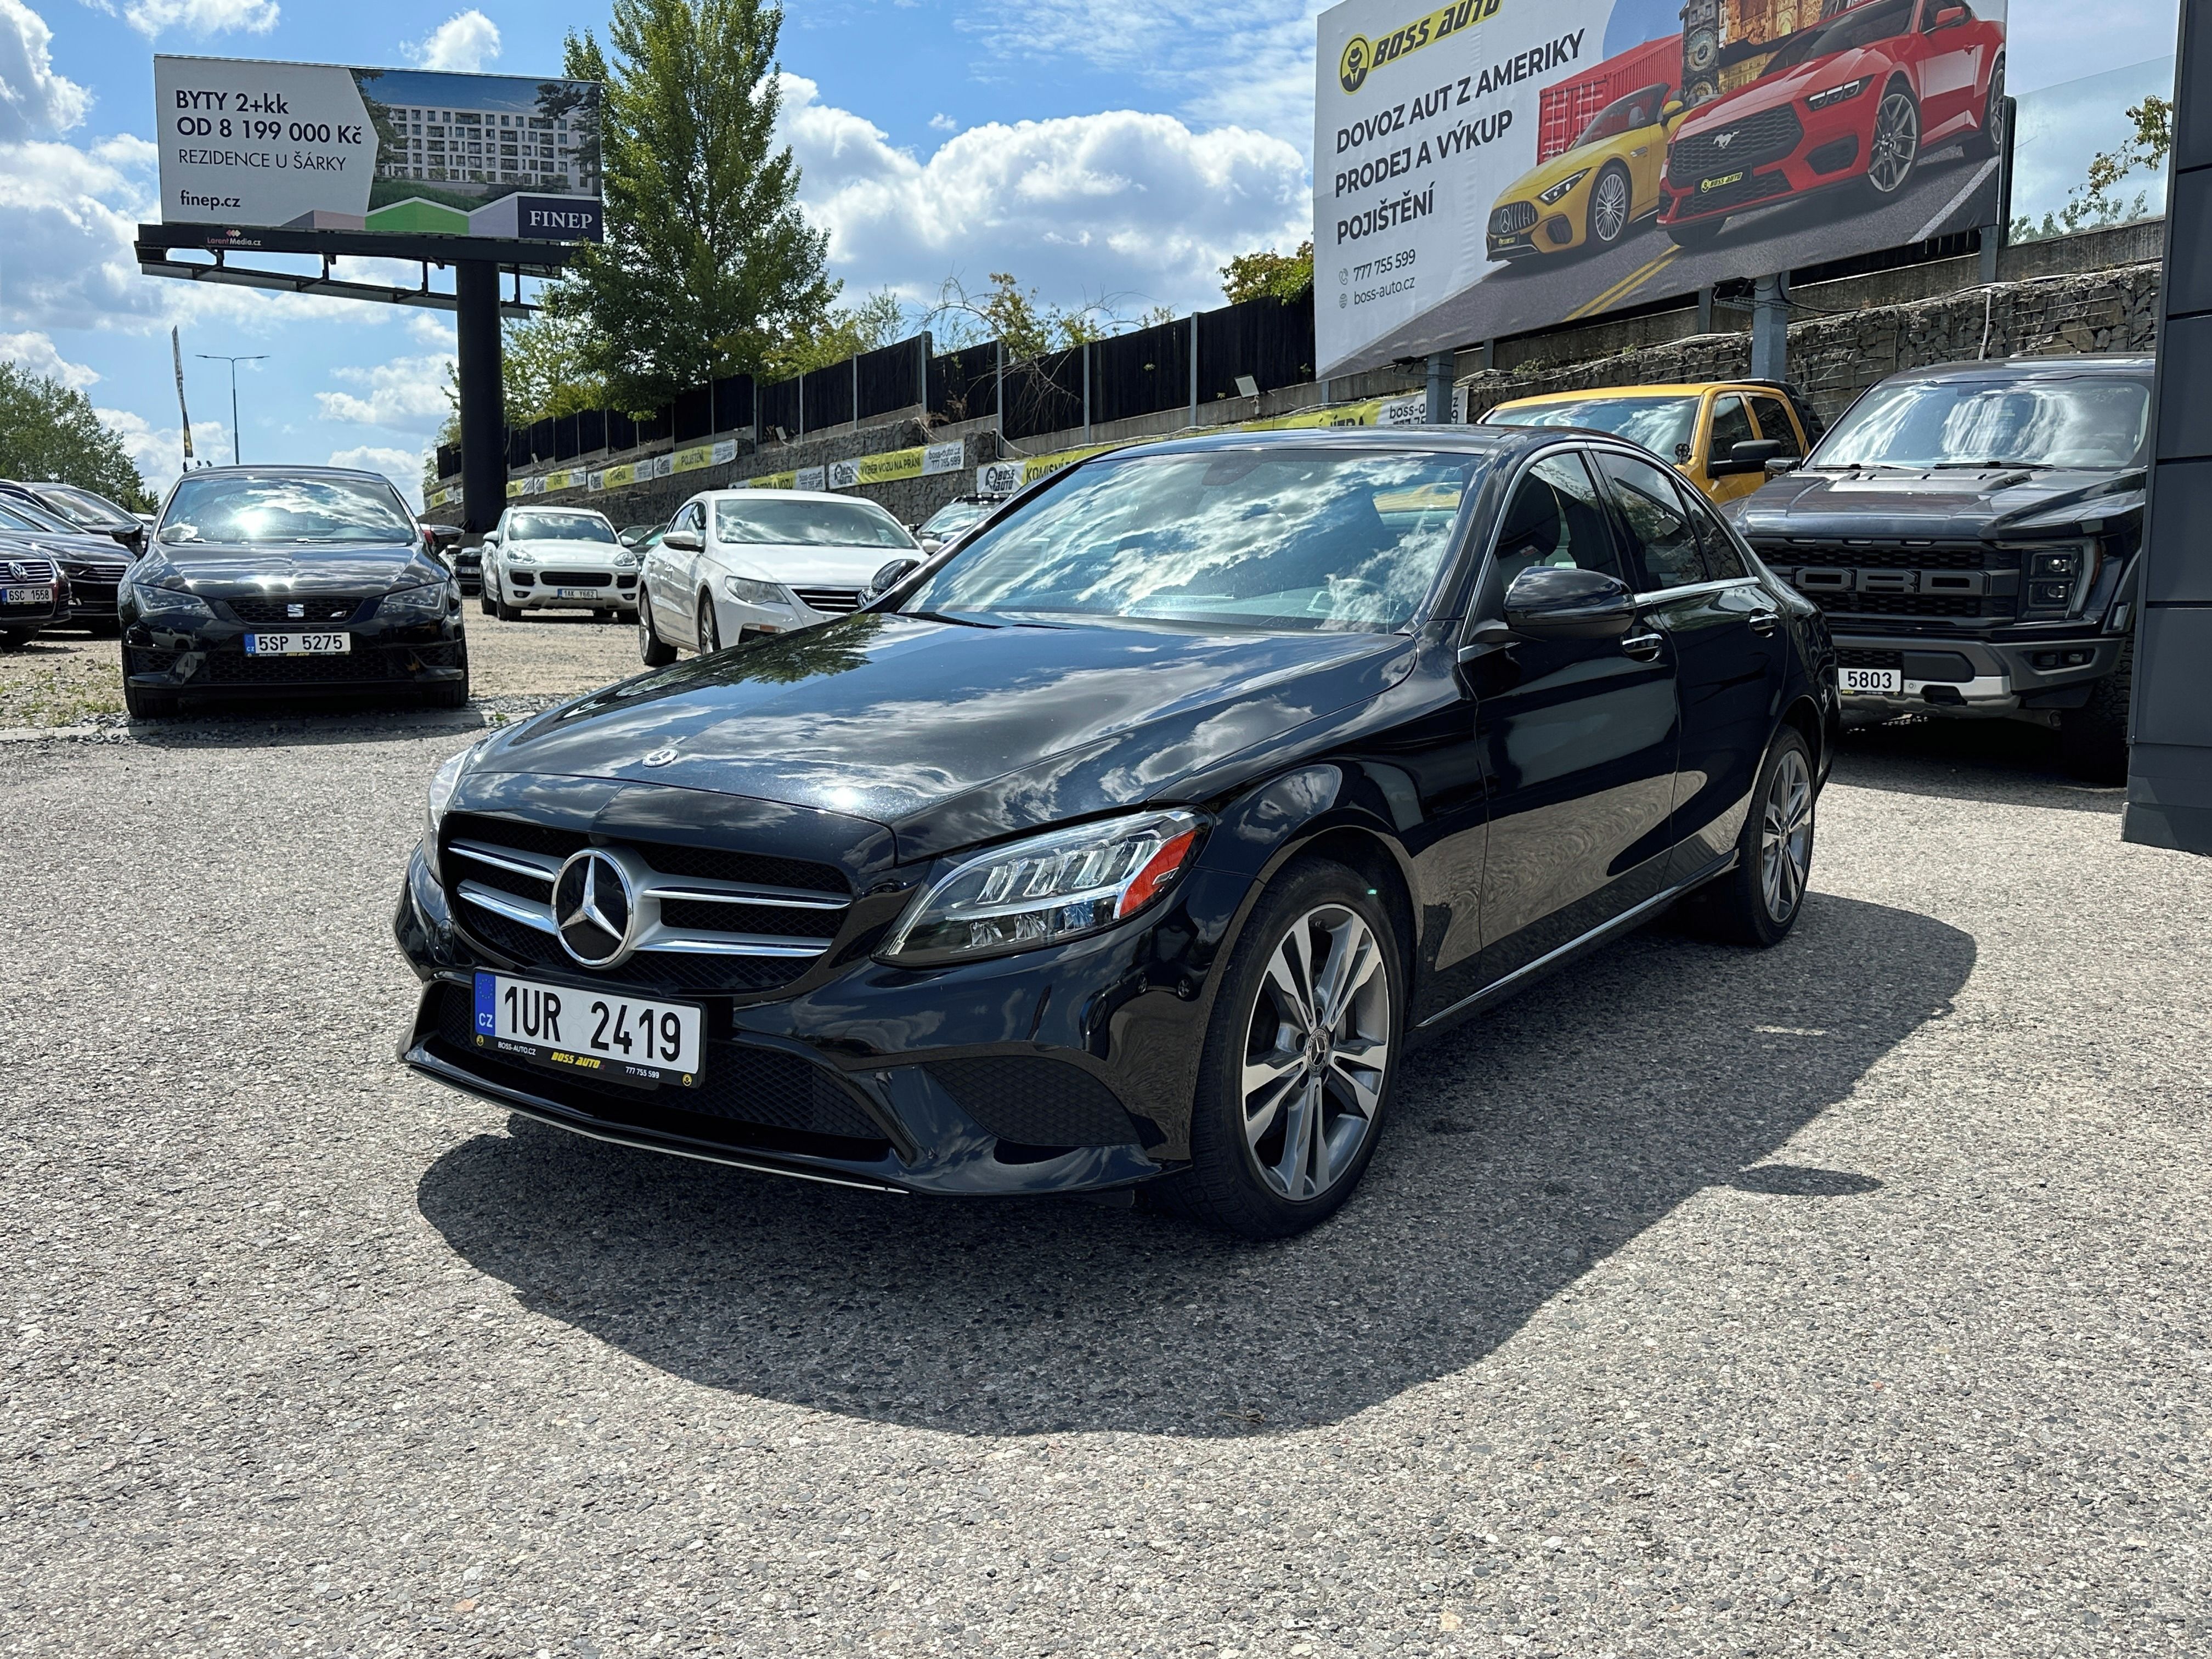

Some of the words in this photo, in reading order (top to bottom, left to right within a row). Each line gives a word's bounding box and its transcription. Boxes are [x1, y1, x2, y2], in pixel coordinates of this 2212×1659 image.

[1372, 18, 1431, 69] BOSS
[176, 90, 228, 110] BYTY
[235, 93, 289, 114] 2+kk
[1337, 103, 1405, 154] DOVOZ
[1409, 84, 1453, 125] AUT
[1457, 76, 1471, 106] Z
[1475, 28, 1585, 99] AMERIKY
[177, 116, 212, 136] OD
[219, 119, 232, 138] 8
[242, 120, 281, 140] 199
[289, 122, 330, 143] 000
[337, 125, 362, 144] Kč
[179, 149, 270, 168] REZIDENCE
[276, 154, 287, 168] U
[294, 151, 346, 171] ŠÁRKY
[1335, 146, 1411, 198] PRODEJ
[1415, 141, 1432, 168] A
[1436, 110, 1513, 159] VÝKUP
[180, 189, 241, 211] finep.cz
[529, 211, 592, 229] FINEP
[1338, 180, 1435, 245] POJIŠTĚNÍ
[1353, 262, 1372, 281] 777
[1374, 256, 1392, 275] 755
[1395, 249, 1416, 268] 599
[1354, 277, 1415, 305] boss-auto.cz
[994, 481, 1013, 491] AUTO
[997, 469, 1015, 481] BOSS
[9, 590, 25, 601] 6SC
[31, 590, 49, 600] 1558
[258, 636, 289, 651] 5SP
[302, 635, 342, 650] 5275
[1848, 671, 1892, 689] 5803
[478, 1013, 493, 1028] CZ
[505, 986, 561, 1042] 1UR
[590, 1001, 681, 1062] 2419
[498, 1041, 536, 1056] BOSS-AUTO.CZ
[551, 1052, 574, 1064] BOSS
[575, 1057, 601, 1069] AUTO
[625, 1066, 635, 1075] 777
